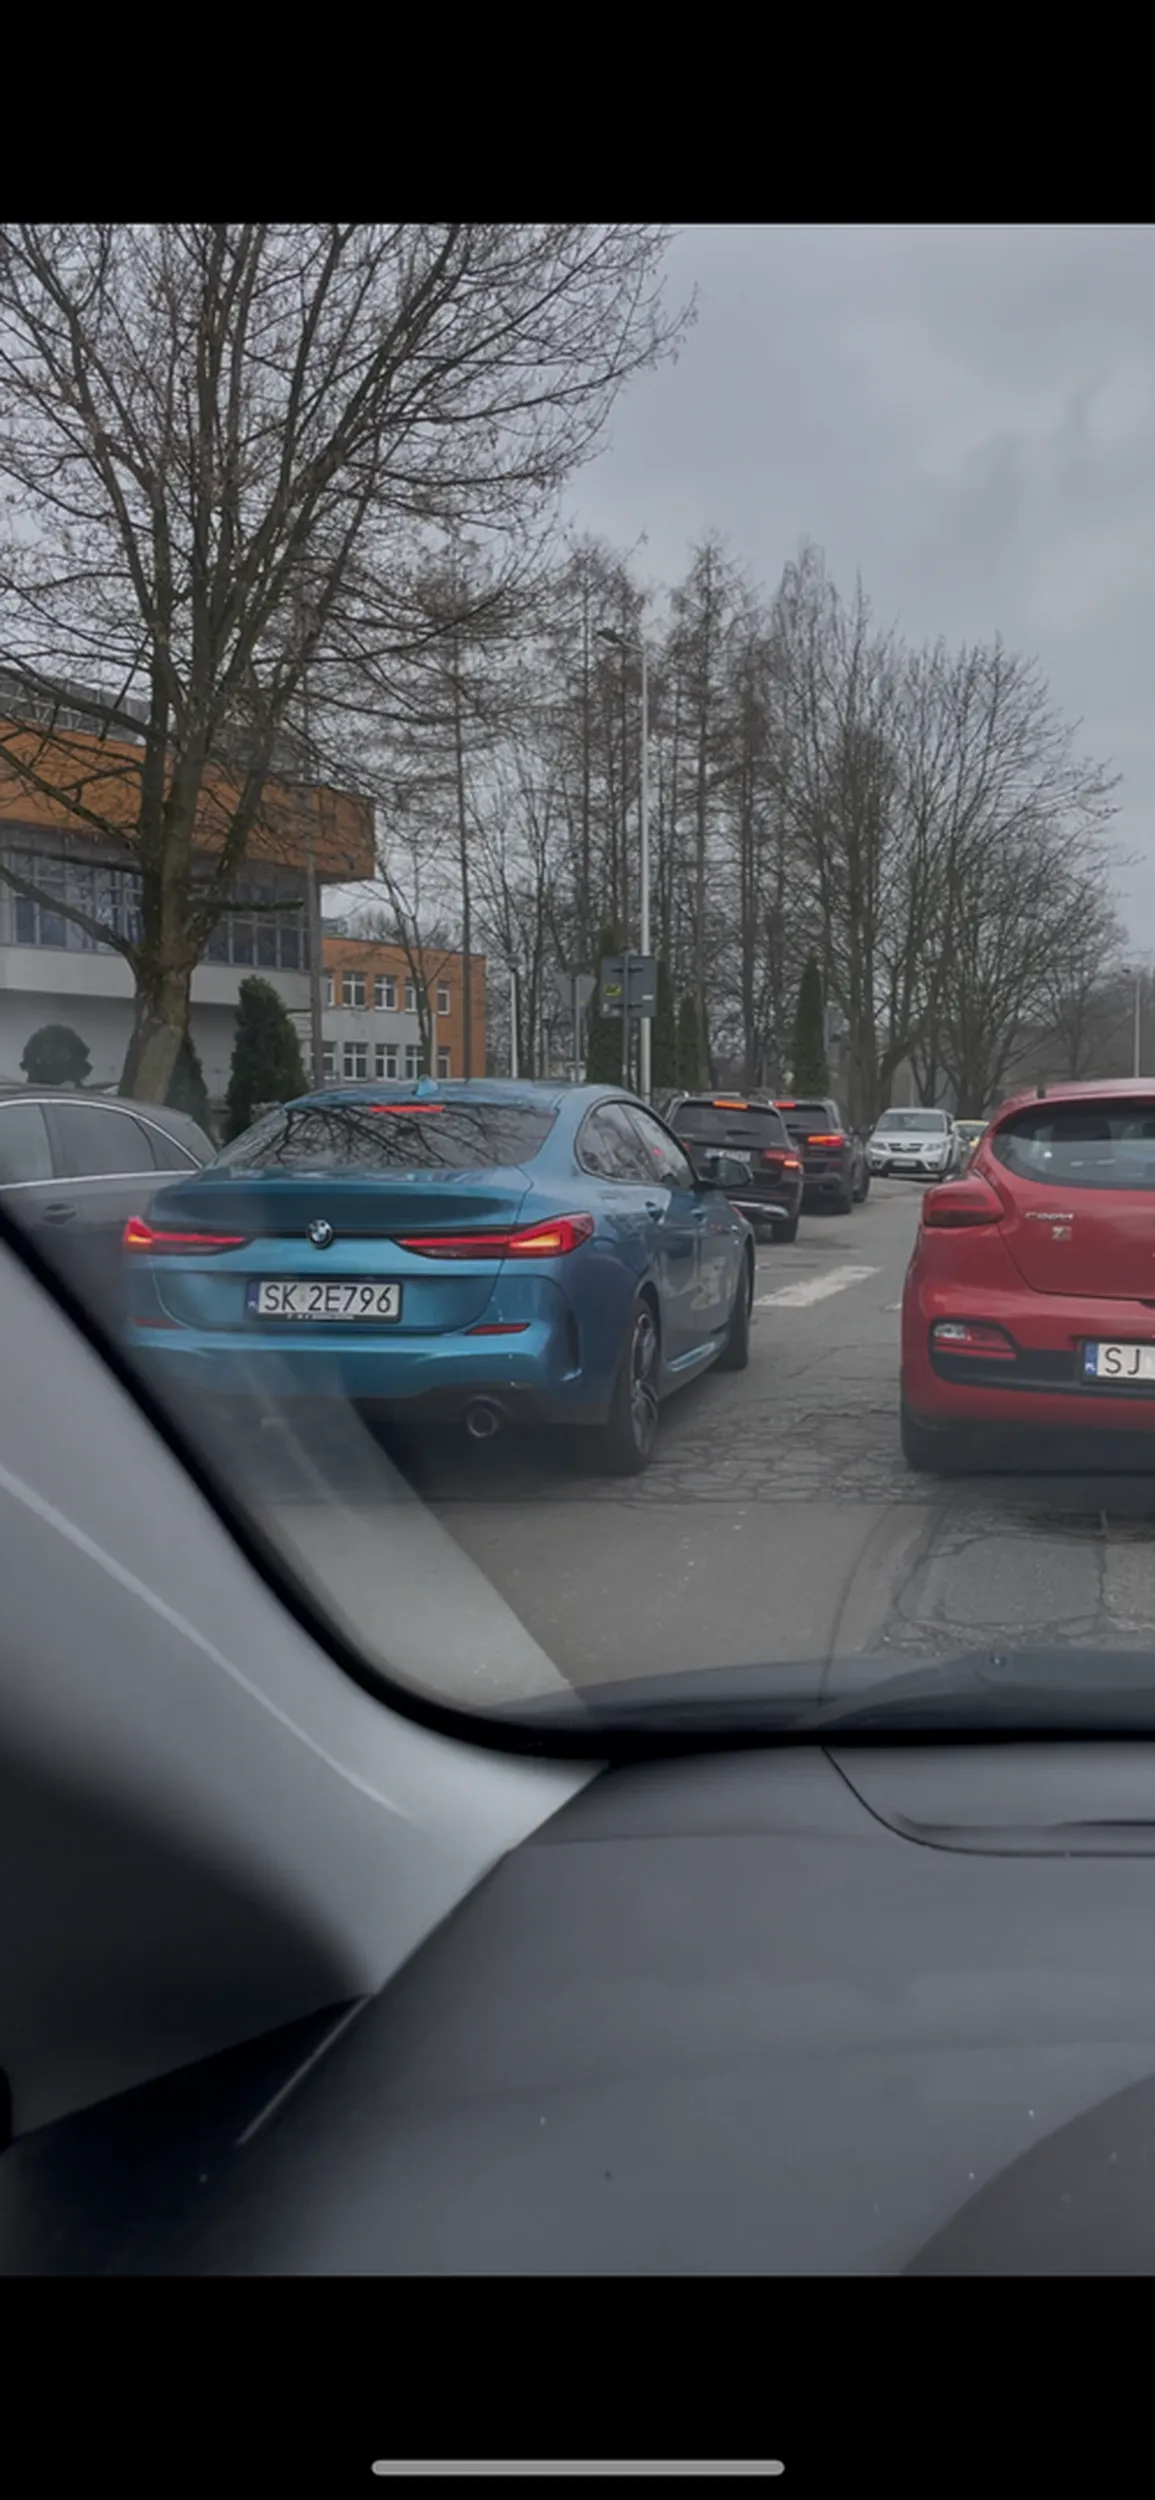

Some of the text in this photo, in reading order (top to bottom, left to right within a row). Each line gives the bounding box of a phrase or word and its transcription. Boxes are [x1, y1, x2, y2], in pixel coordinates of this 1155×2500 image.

[265, 1284, 392, 1314] SK 2E796
[1105, 1347, 1141, 1375] SJ
